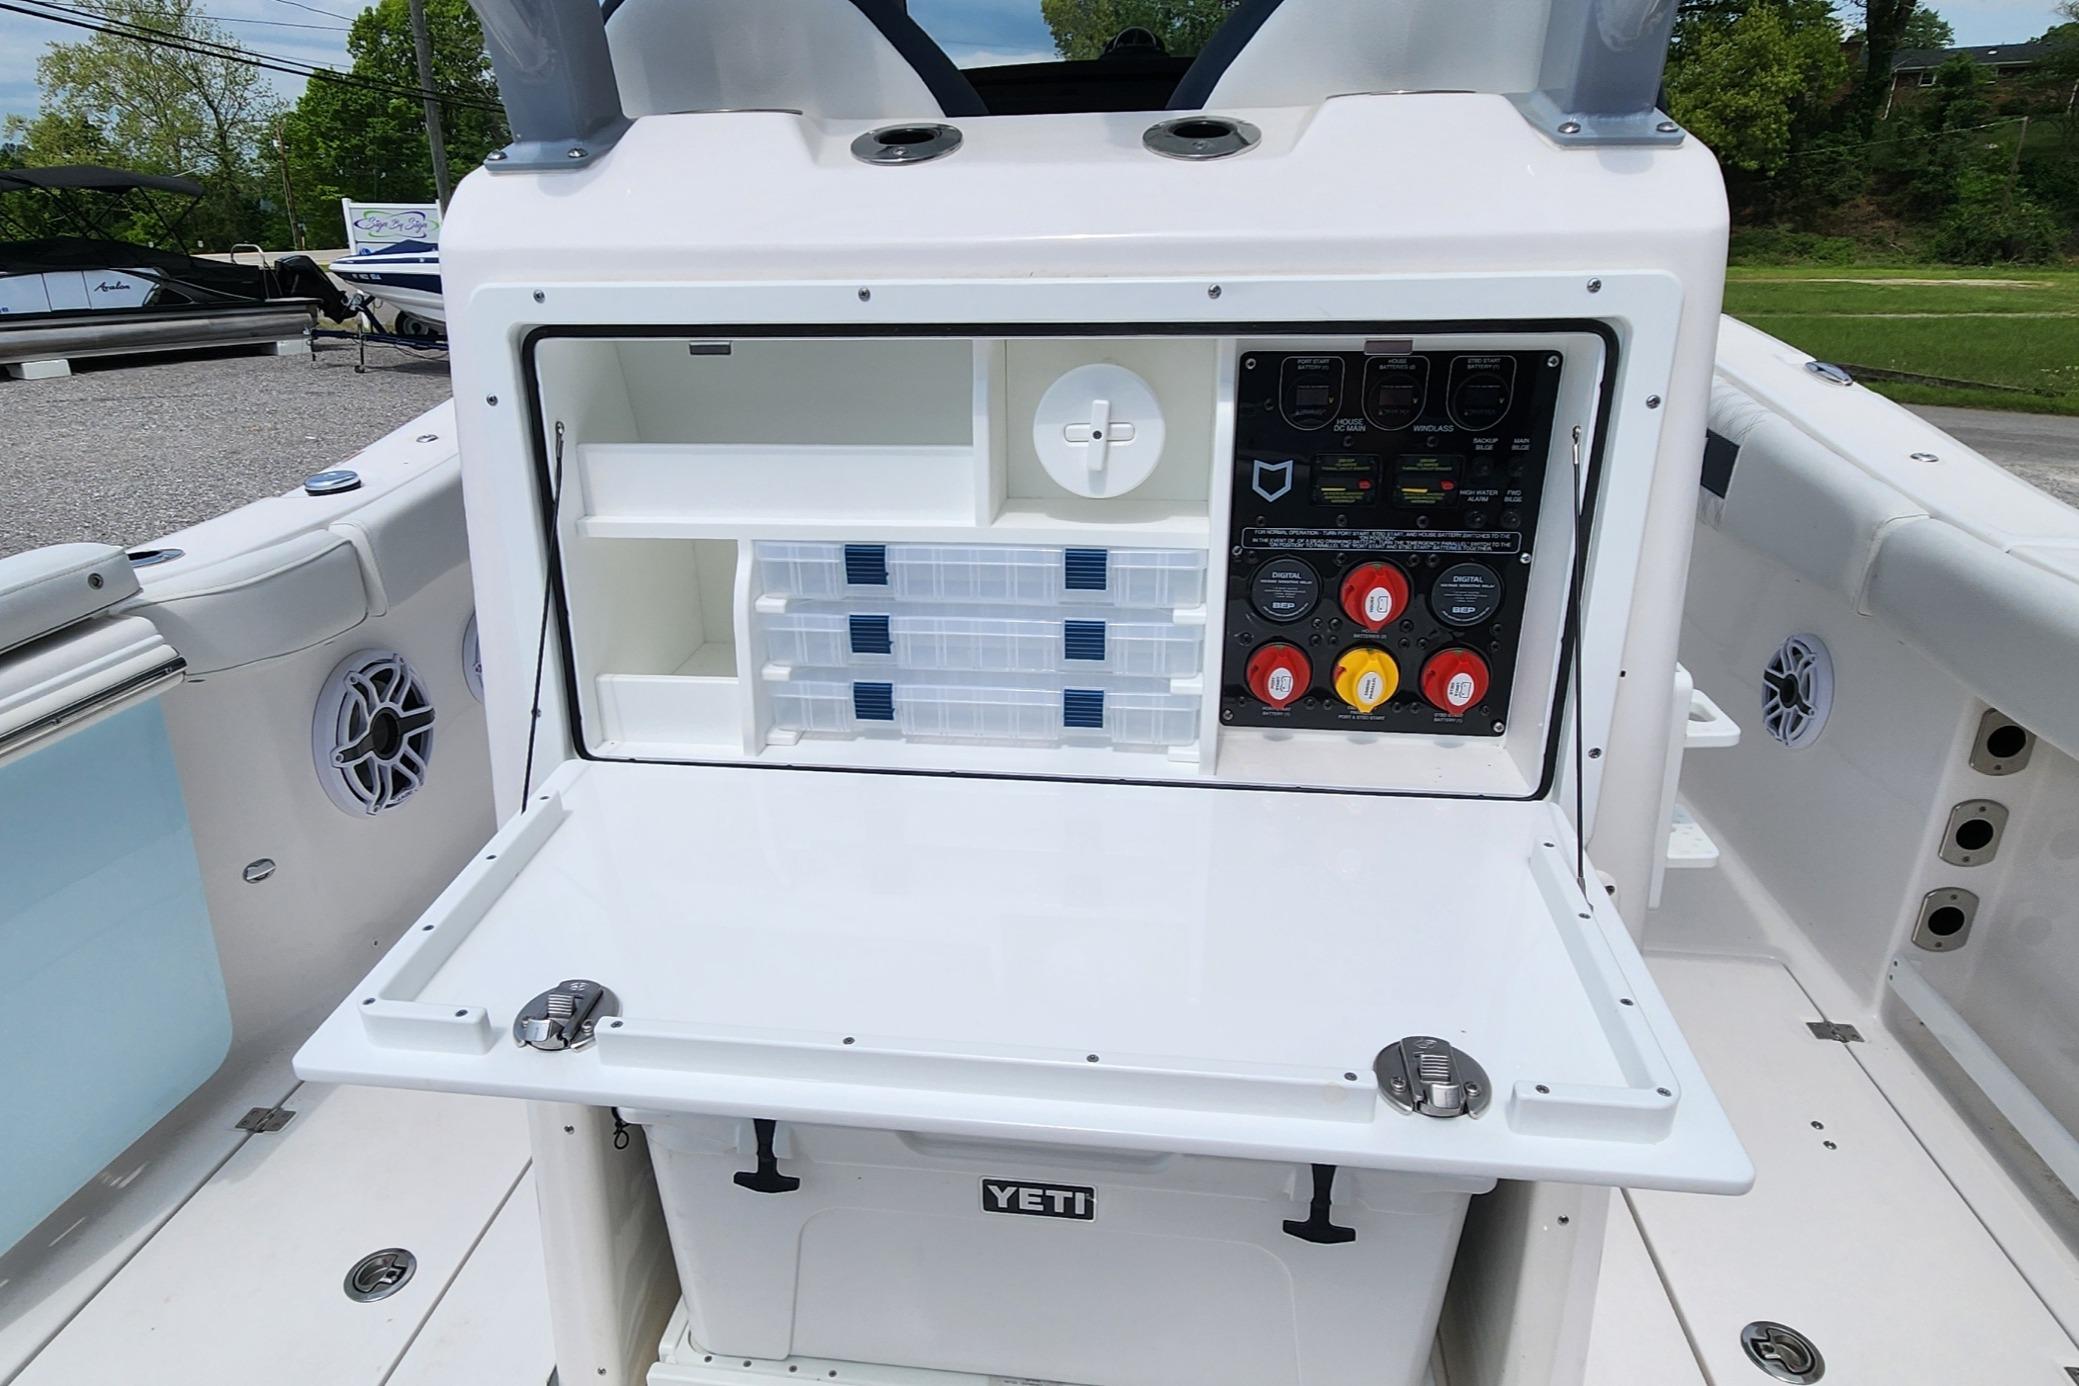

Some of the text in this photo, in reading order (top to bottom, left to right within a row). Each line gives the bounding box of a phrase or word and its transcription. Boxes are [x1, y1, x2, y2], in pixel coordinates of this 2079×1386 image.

[364, 216, 428, 233] Sign By Sign
[94, 281, 131, 292] Avalon
[1272, 571, 1302, 579] DIGITAL
[1453, 575, 1484, 583] DIGITAL
[1452, 606, 1476, 614] BEP
[987, 1185, 1086, 1215] YETI
